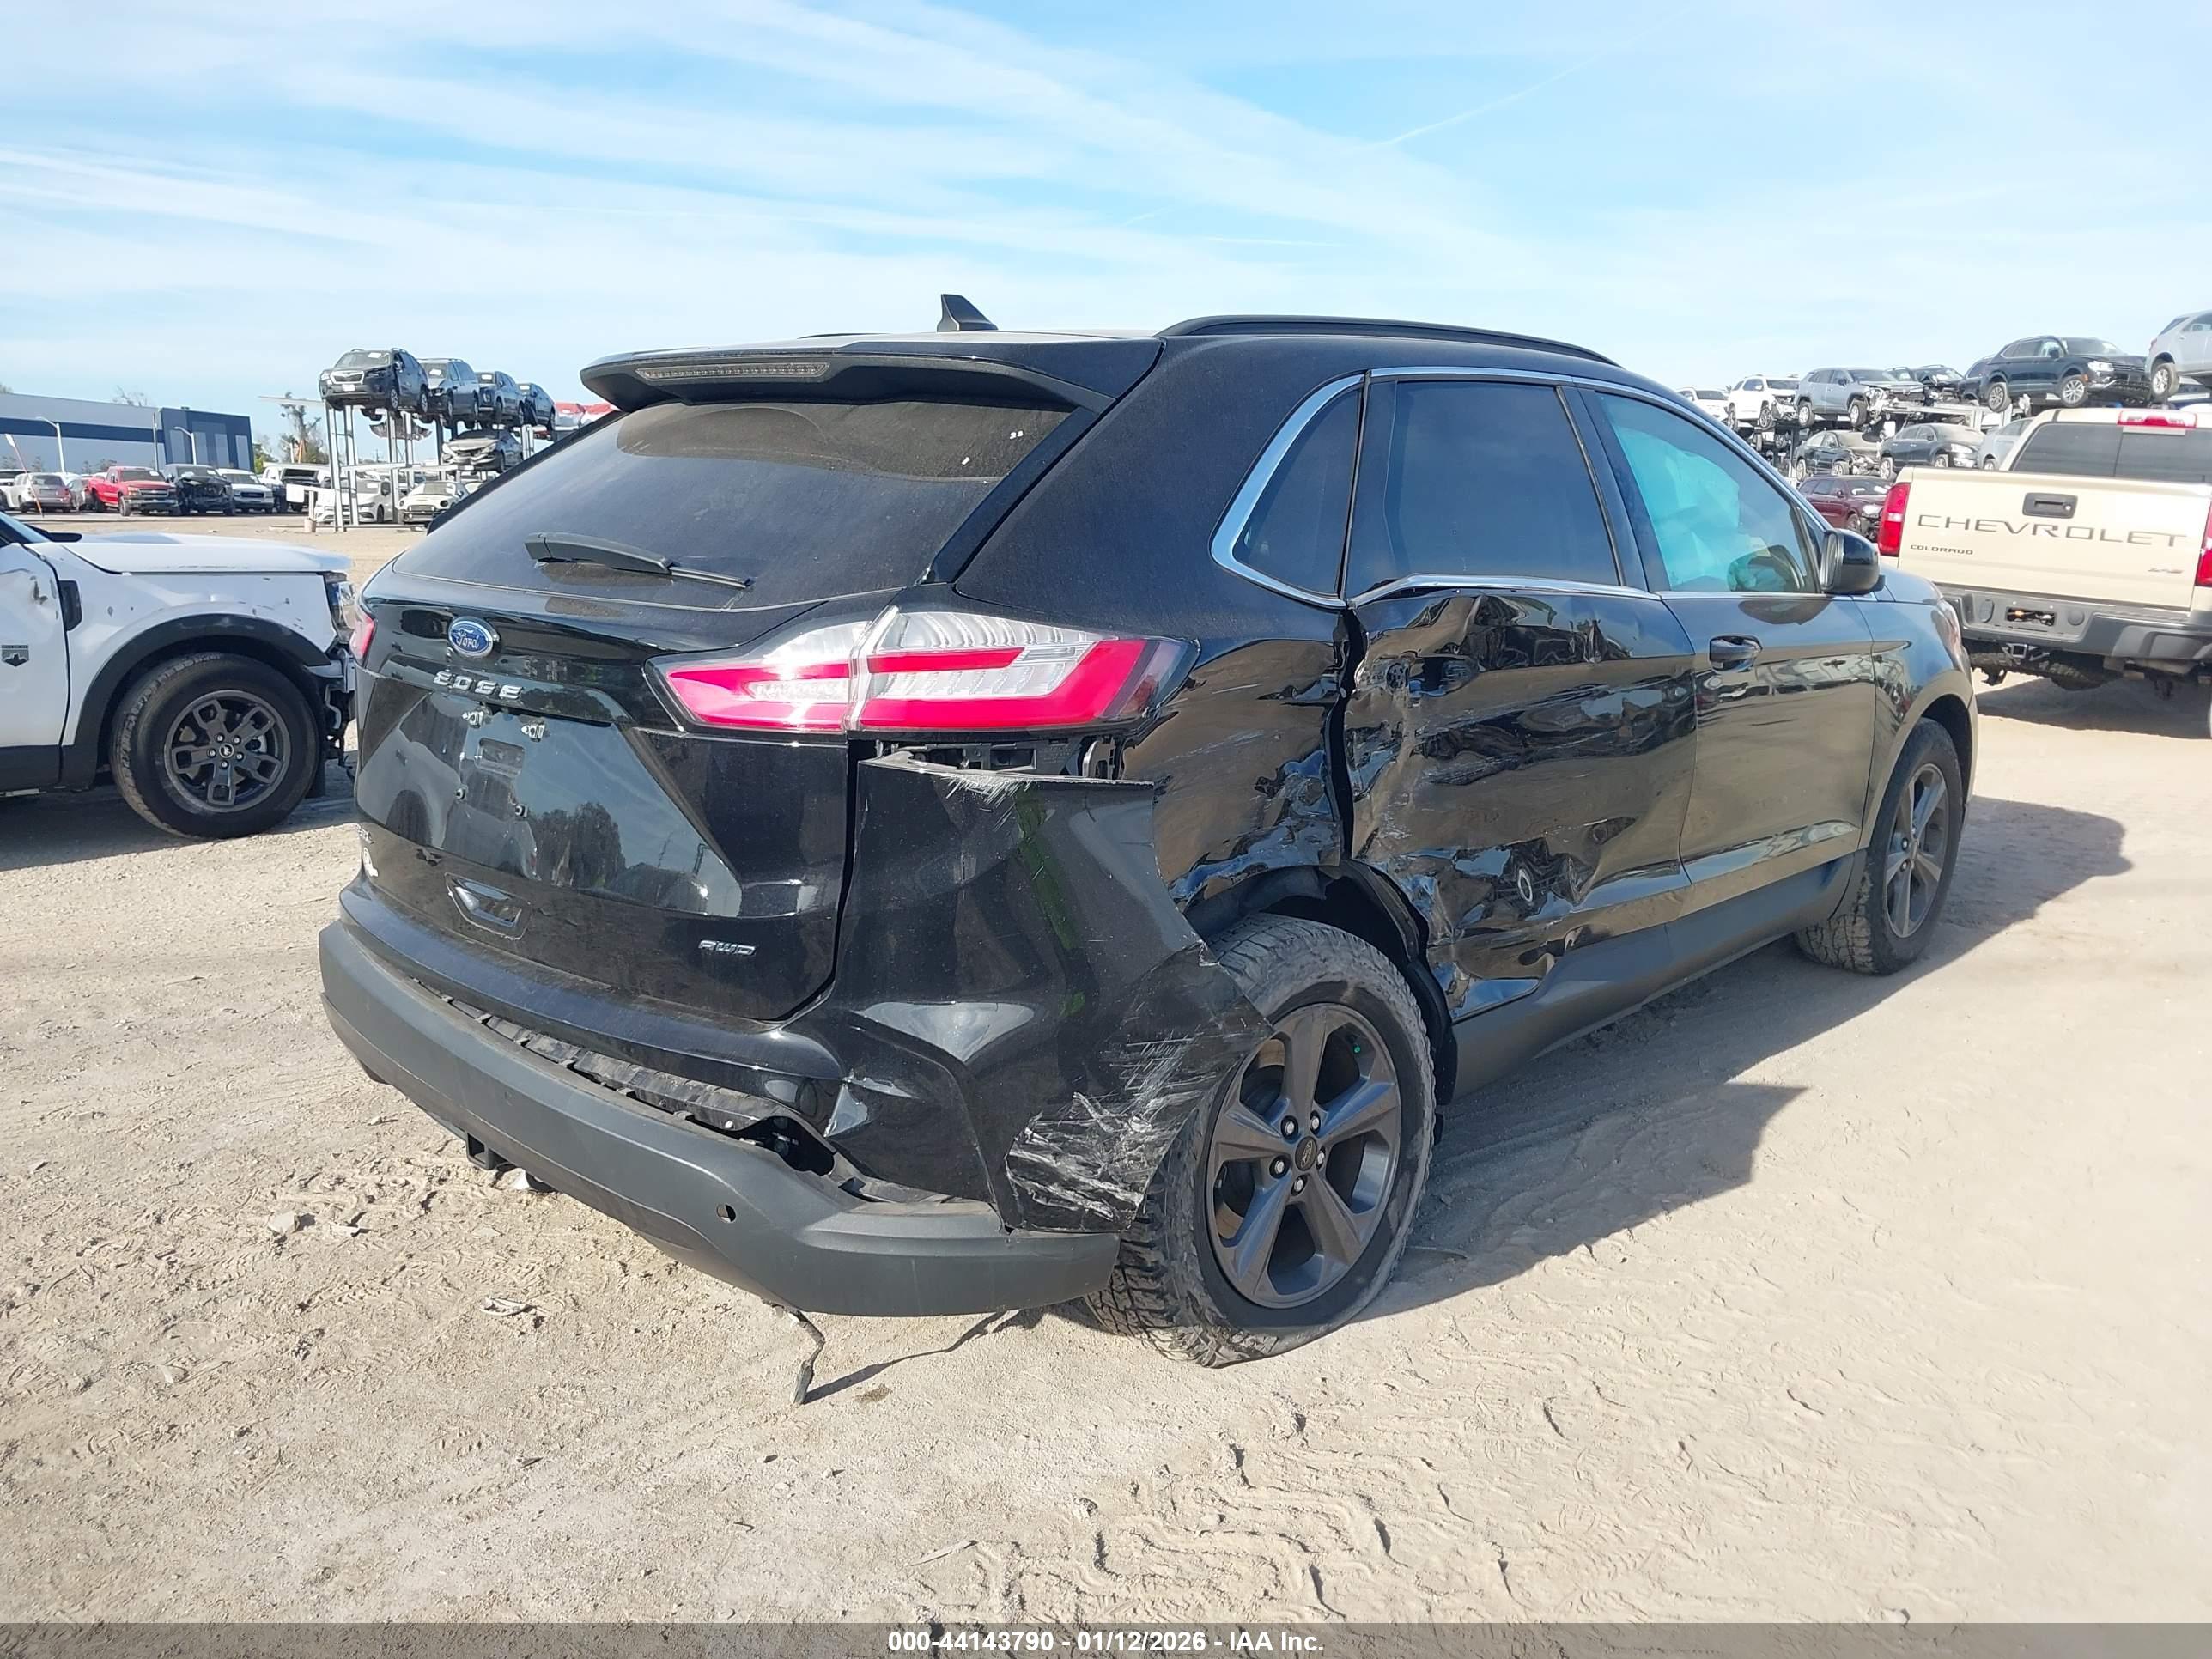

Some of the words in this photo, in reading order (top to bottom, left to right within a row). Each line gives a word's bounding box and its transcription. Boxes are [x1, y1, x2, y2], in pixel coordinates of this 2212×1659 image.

[1917, 514, 2187, 547] CHEVROLET
[1910, 544, 1973, 556] COLORADO
[452, 627, 481, 649] Ford
[434, 671, 522, 699] EDGE
[698, 939, 756, 955] AWD
